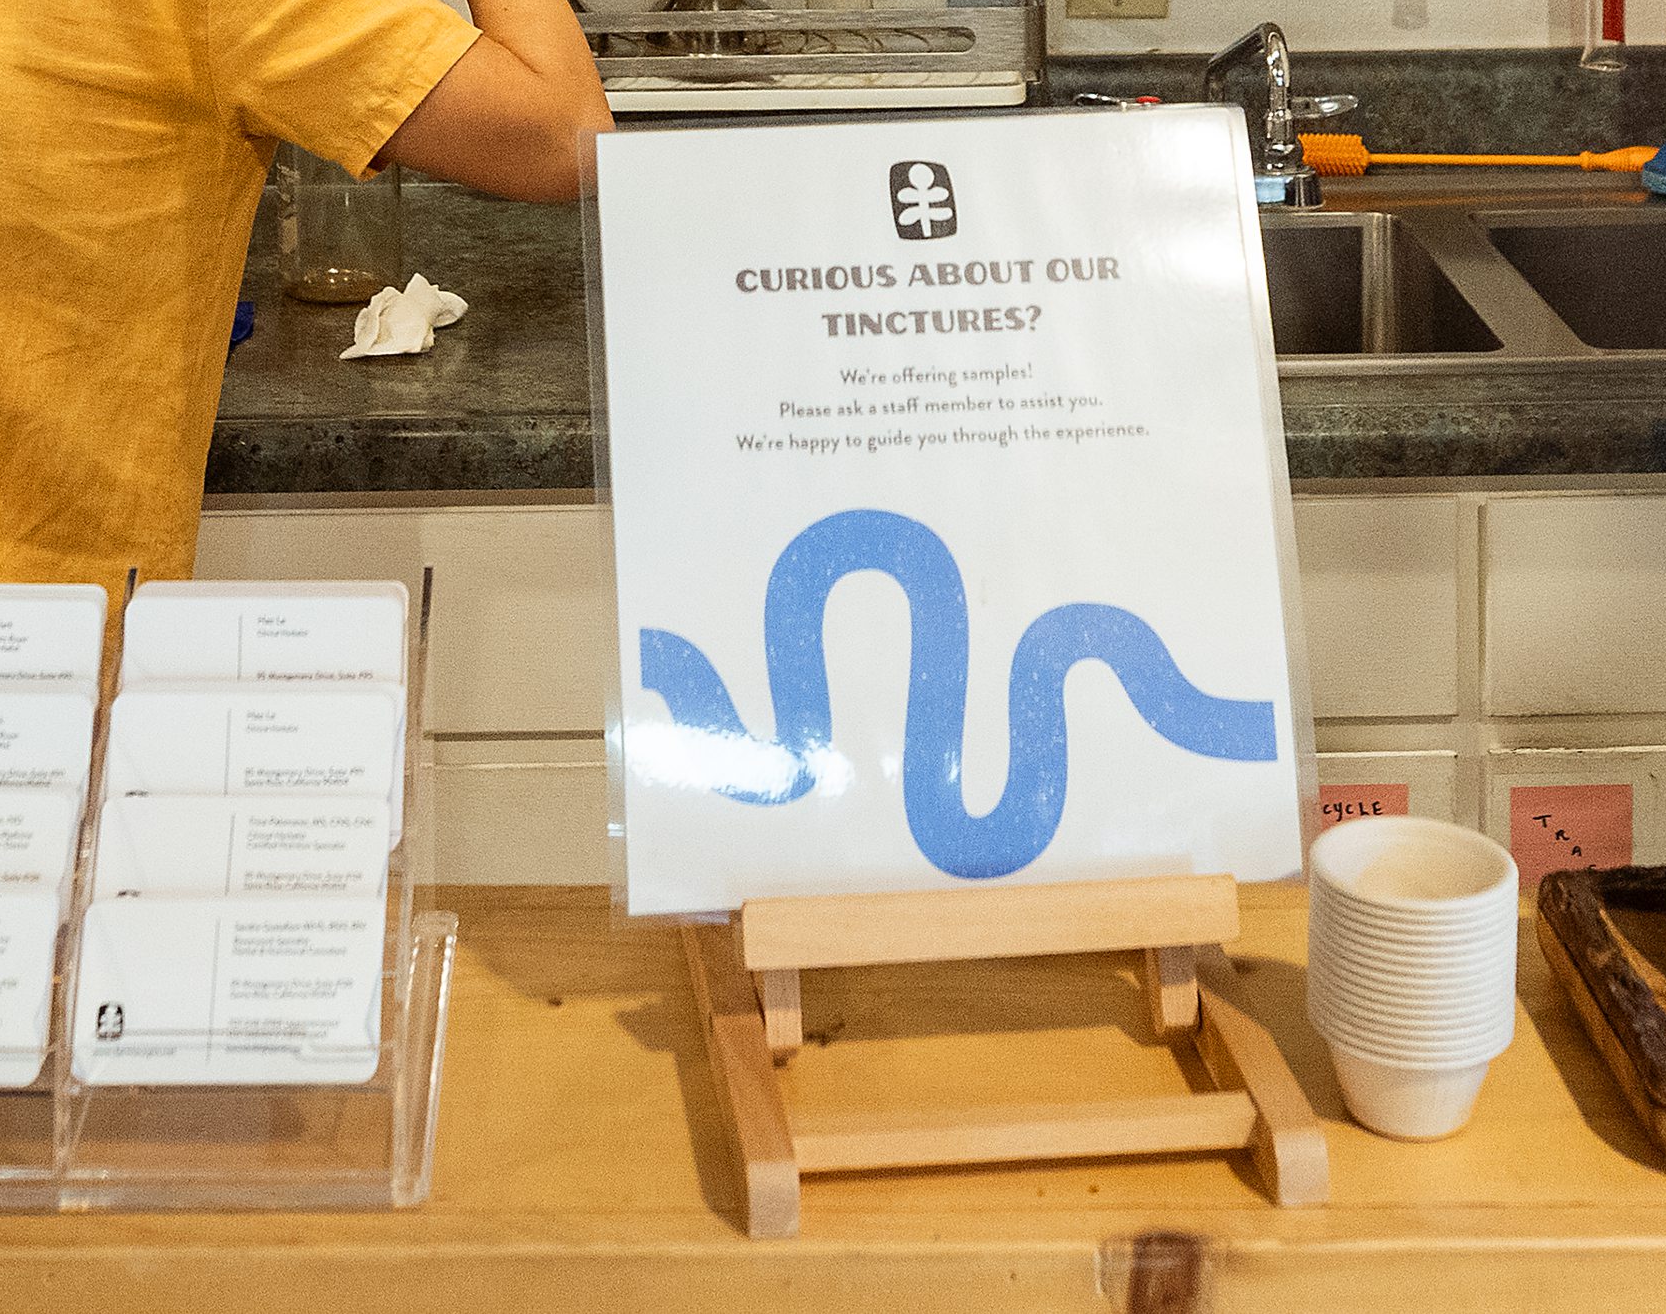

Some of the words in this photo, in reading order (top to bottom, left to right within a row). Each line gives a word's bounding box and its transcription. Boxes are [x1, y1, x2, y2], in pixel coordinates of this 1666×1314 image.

[736, 265, 897, 293] CURIOUS
[908, 261, 1035, 286] ABOUT
[1046, 257, 1121, 281] OUR
[821, 306, 1042, 337] TINCTURES?
[840, 369, 887, 385] We're
[892, 367, 958, 388] offering
[963, 364, 1033, 385] samples!
[779, 402, 832, 418] Please
[837, 401, 863, 416] ask
[869, 405, 878, 416] a
[883, 398, 918, 415] staff
[925, 398, 991, 412] member
[999, 398, 1014, 410] to
[1020, 395, 1063, 410] assist
[1069, 395, 1103, 412] you.
[737, 434, 783, 450] We're
[790, 434, 840, 453] happy
[847, 434, 862, 448] to
[868, 430, 912, 450] guide
[919, 433, 947, 450] you
[953, 427, 1018, 447] through
[1025, 424, 1049, 440] the
[1057, 423, 1150, 442] experience.
